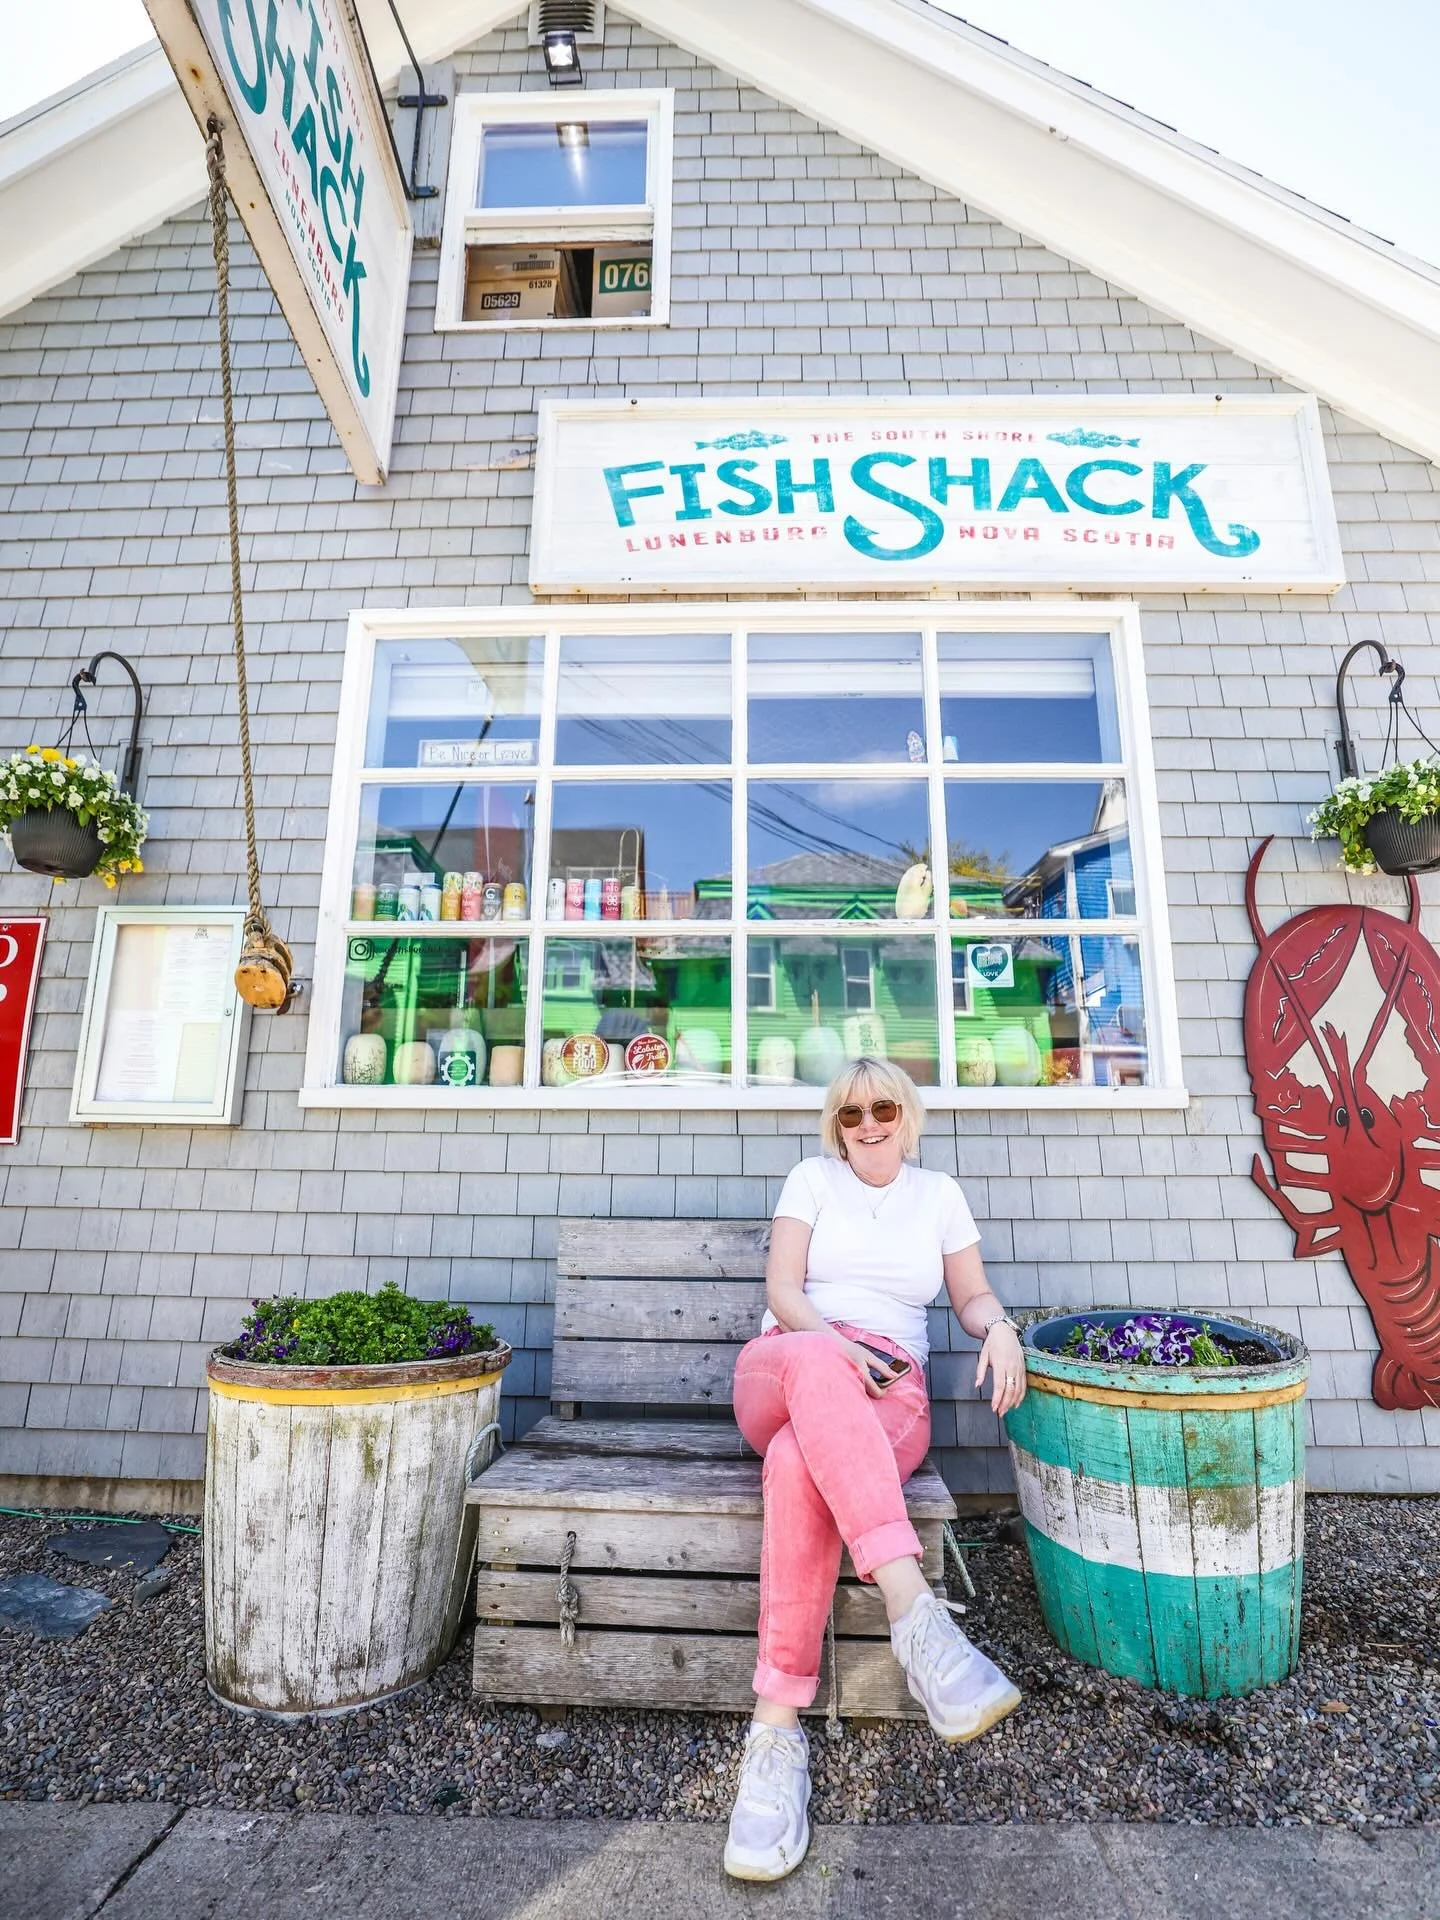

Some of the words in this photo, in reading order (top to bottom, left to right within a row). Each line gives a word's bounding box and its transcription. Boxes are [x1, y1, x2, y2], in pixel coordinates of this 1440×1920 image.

[296, 0, 366, 230] ISH
[274, 128, 344, 323] LUNENBURG
[284, 188, 305, 243] NOVA
[307, 249, 331, 311] SCOTIA
[604, 262, 653, 289] 076
[483, 293, 519, 308] 05629
[810, 432, 854, 444] THE
[871, 430, 946, 441] SOUTH
[602, 458, 836, 528] FISH
[843, 451, 1261, 561] SHACK
[625, 525, 828, 552] LUNENBURG
[959, 525, 1040, 541] NOVA
[1063, 527, 1175, 549] SCOTIA
[573, 1043, 597, 1057] SEA
[633, 1044, 665, 1055] Lobster
[573, 1058, 597, 1069] FOOD
